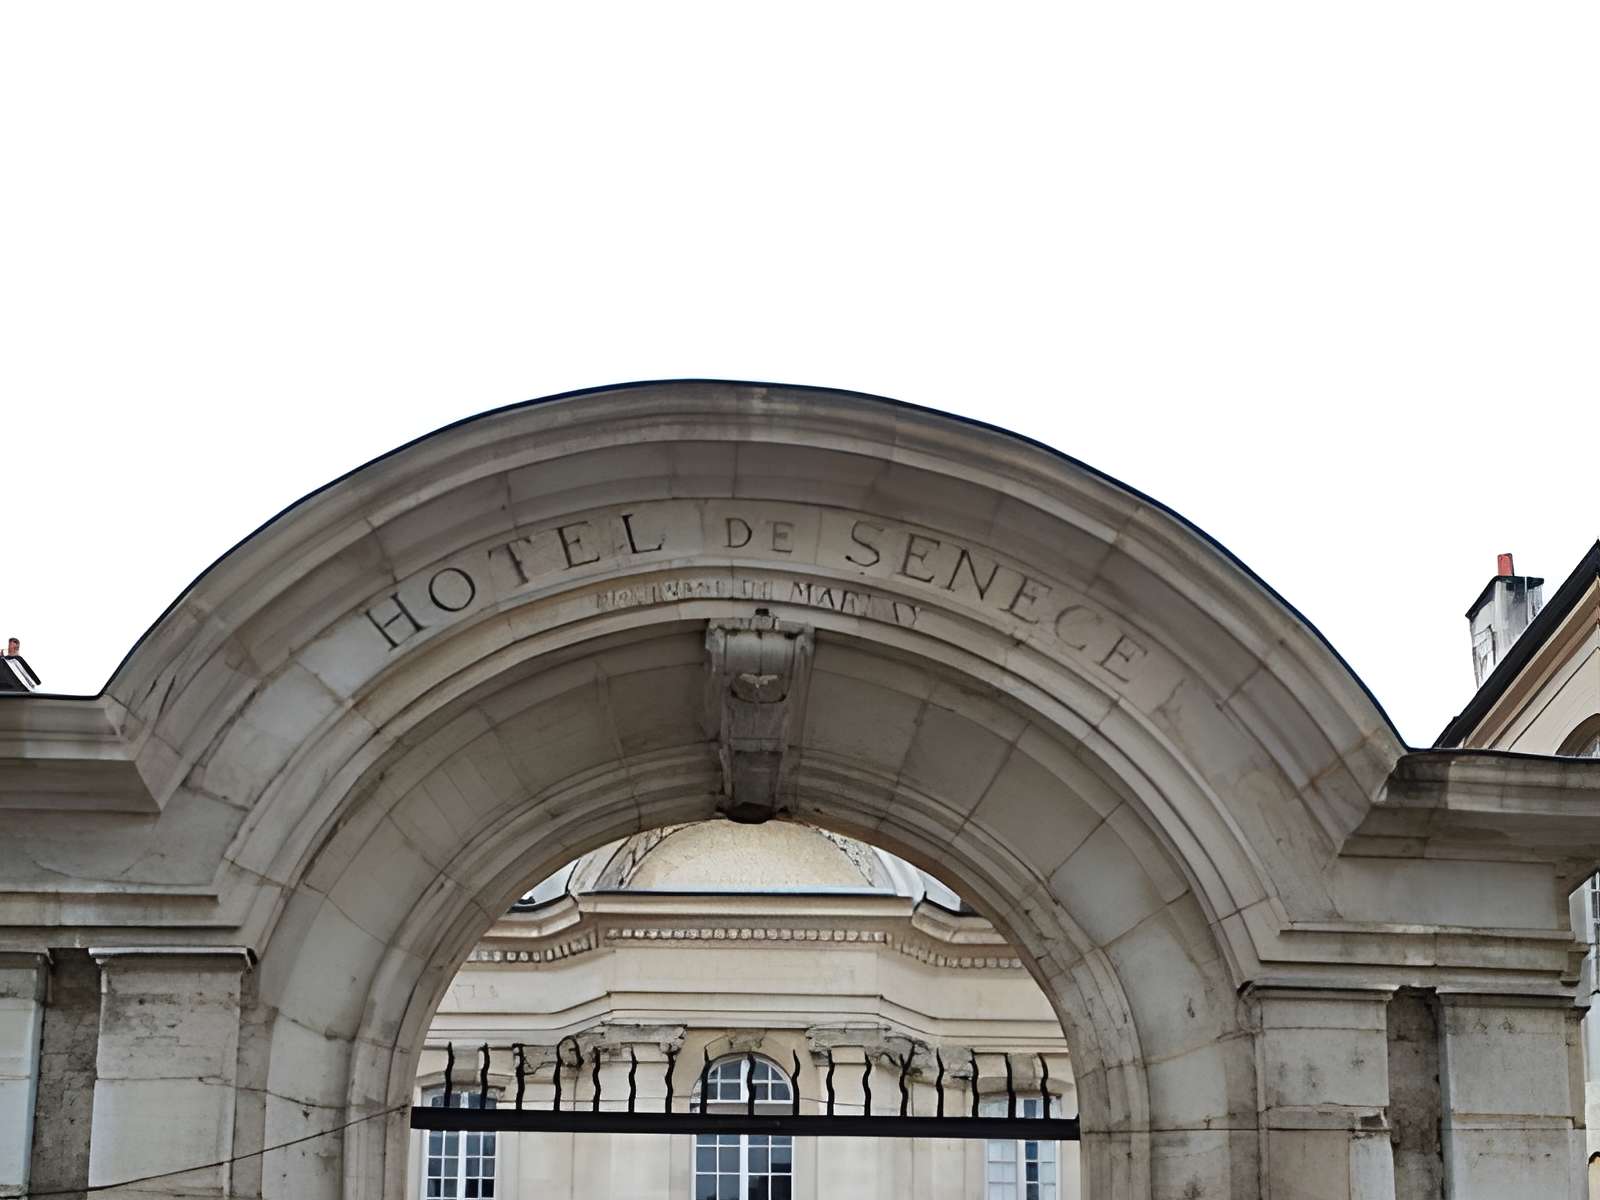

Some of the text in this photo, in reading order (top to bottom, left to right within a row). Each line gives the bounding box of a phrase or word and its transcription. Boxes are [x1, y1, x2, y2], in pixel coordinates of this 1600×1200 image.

[363, 512, 1149, 683] HOTEL DE SENECE
